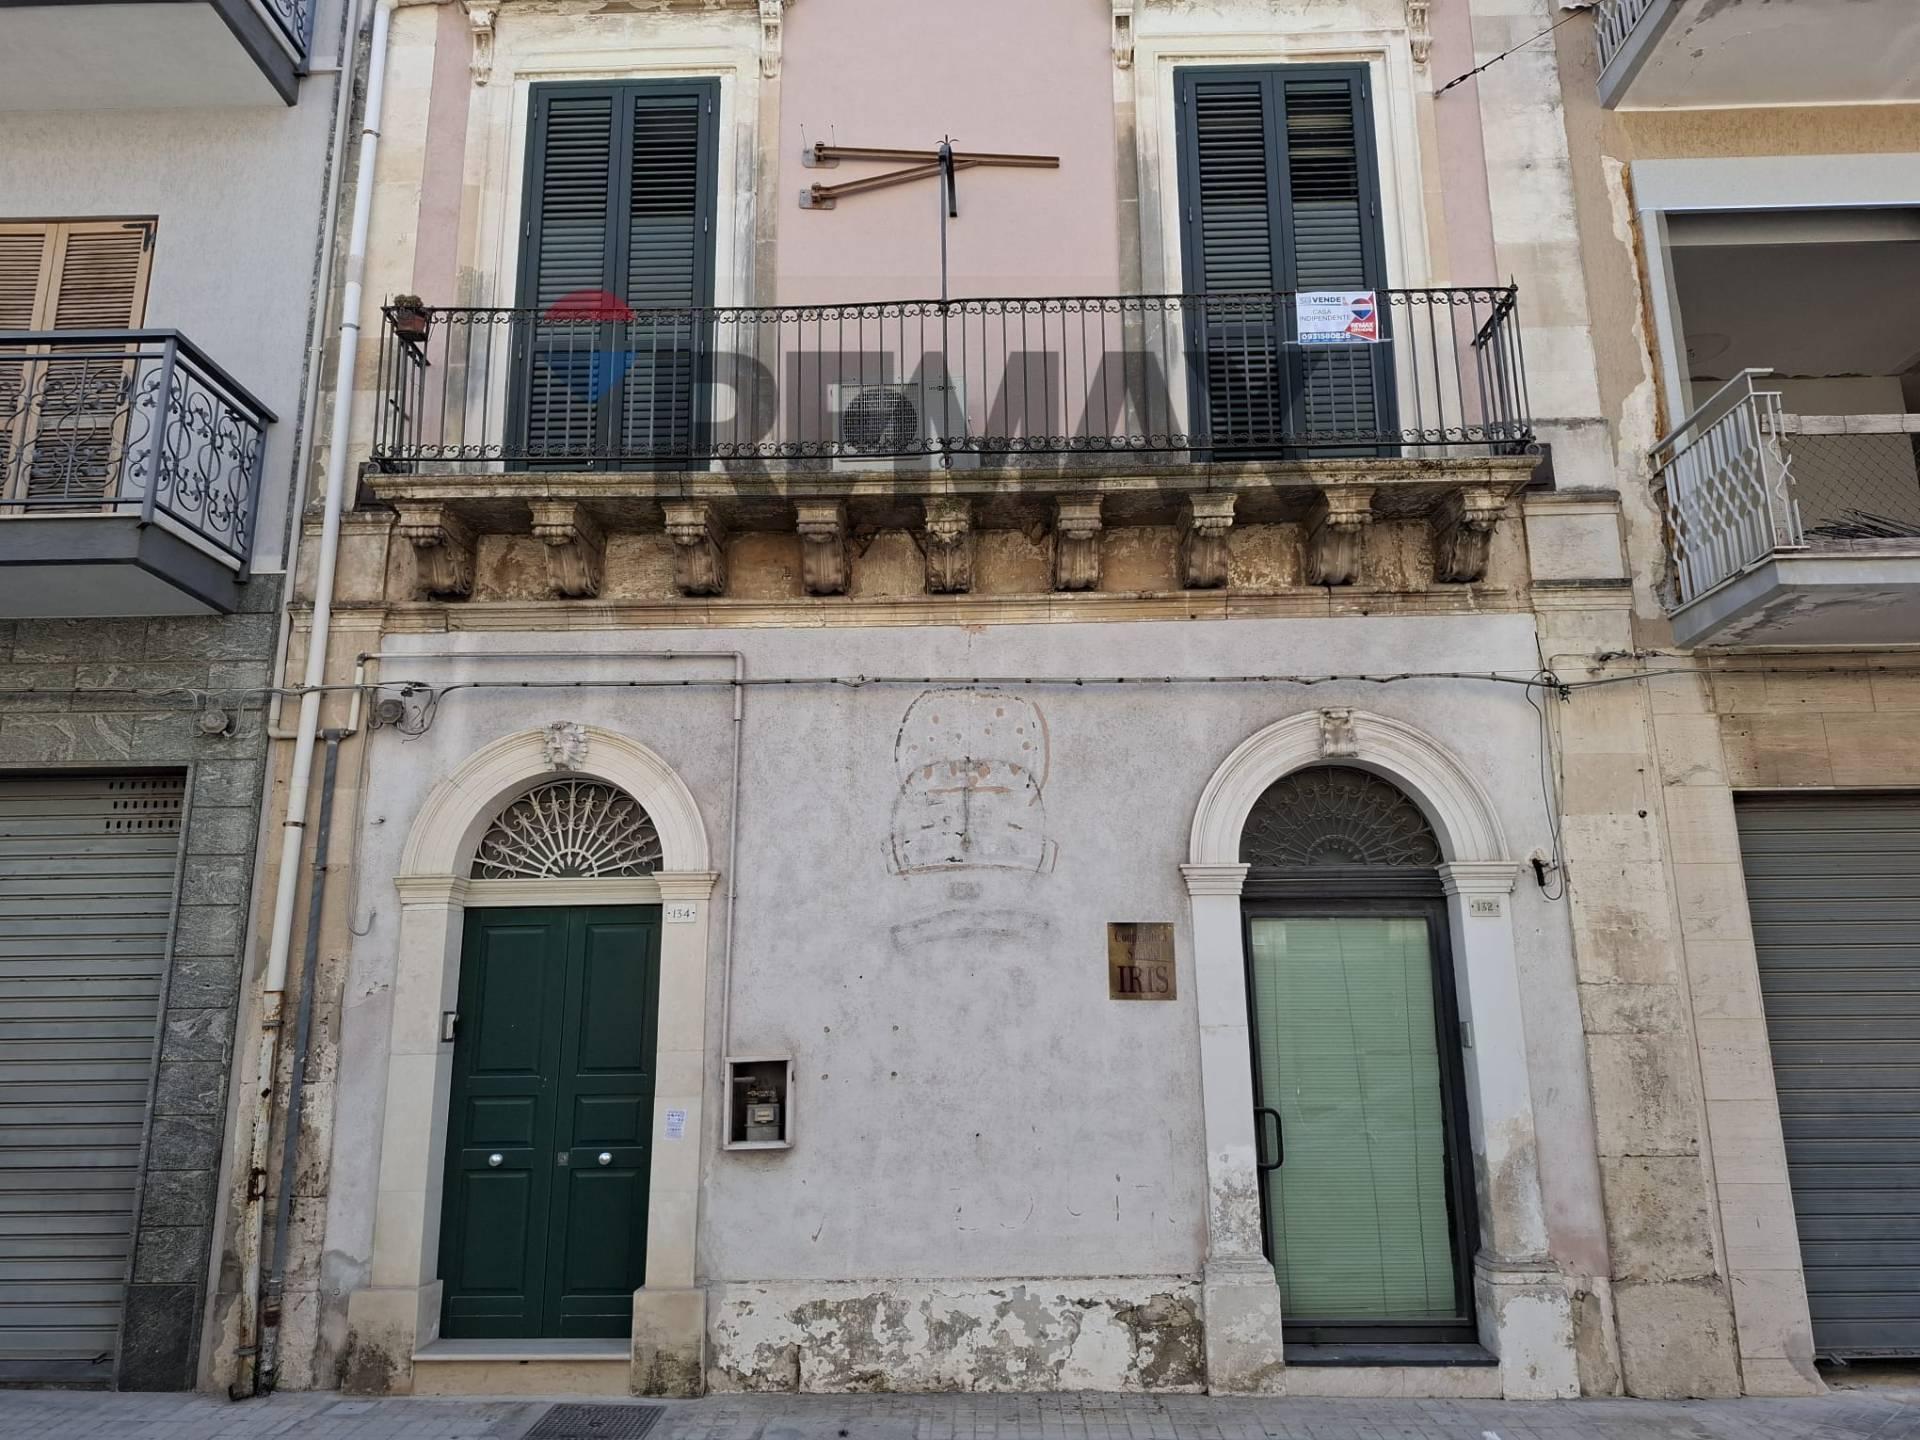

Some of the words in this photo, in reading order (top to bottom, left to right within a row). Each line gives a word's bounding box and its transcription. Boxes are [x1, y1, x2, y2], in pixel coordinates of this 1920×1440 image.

[1477, 902, 1493, 912] 132
[672, 908, 690, 919] 134
[1117, 965, 1168, 993] IRIS
